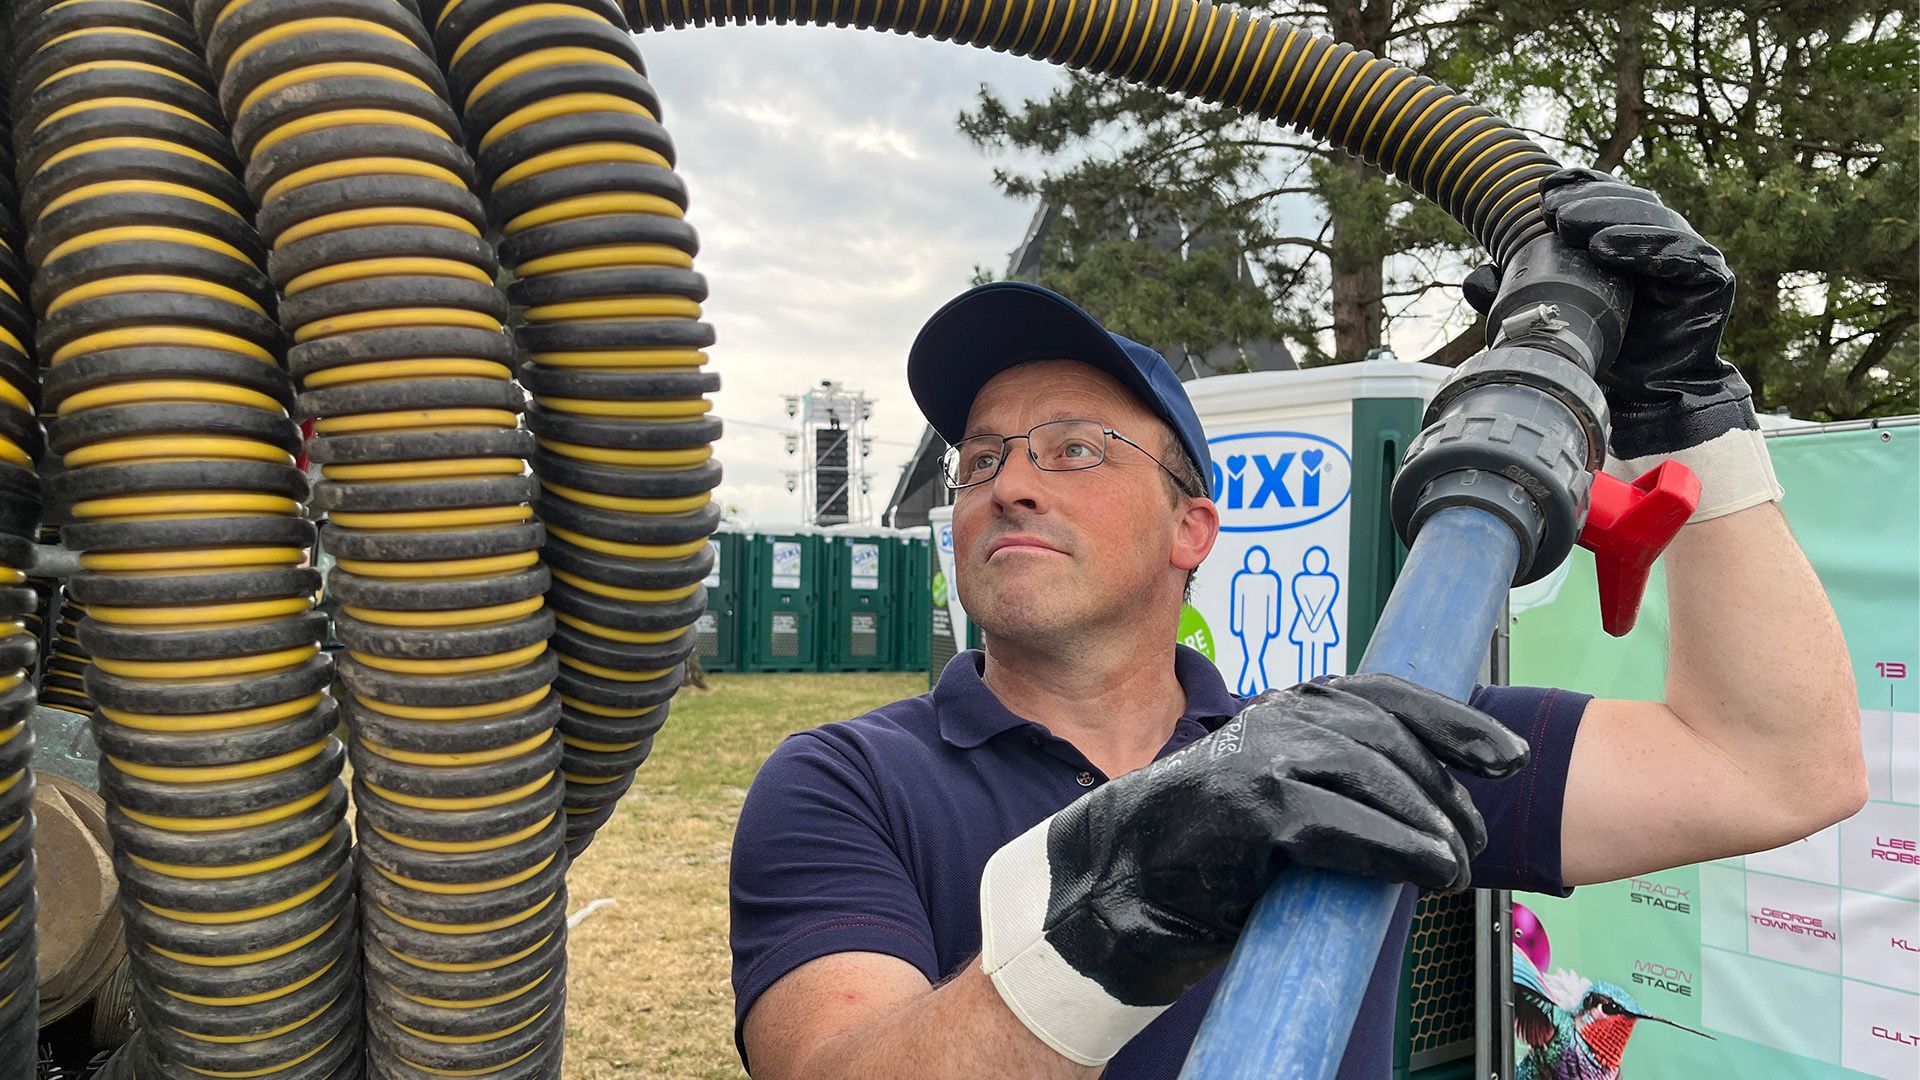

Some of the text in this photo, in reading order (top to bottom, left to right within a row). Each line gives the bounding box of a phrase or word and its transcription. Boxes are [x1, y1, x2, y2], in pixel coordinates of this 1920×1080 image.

[1875, 661, 1906, 679] 13
[1876, 836, 1916, 851] LEE
[1629, 879, 1690, 900] TRACK
[1630, 892, 1691, 914] STAGE
[1750, 914, 1837, 941] TOWNSTON
[1761, 907, 1823, 928] GEORGE
[1891, 937, 1920, 952] KL
[1634, 959, 1693, 984] MOON
[1631, 973, 1692, 997] STAGE
[1872, 1026, 1920, 1046] CULT
